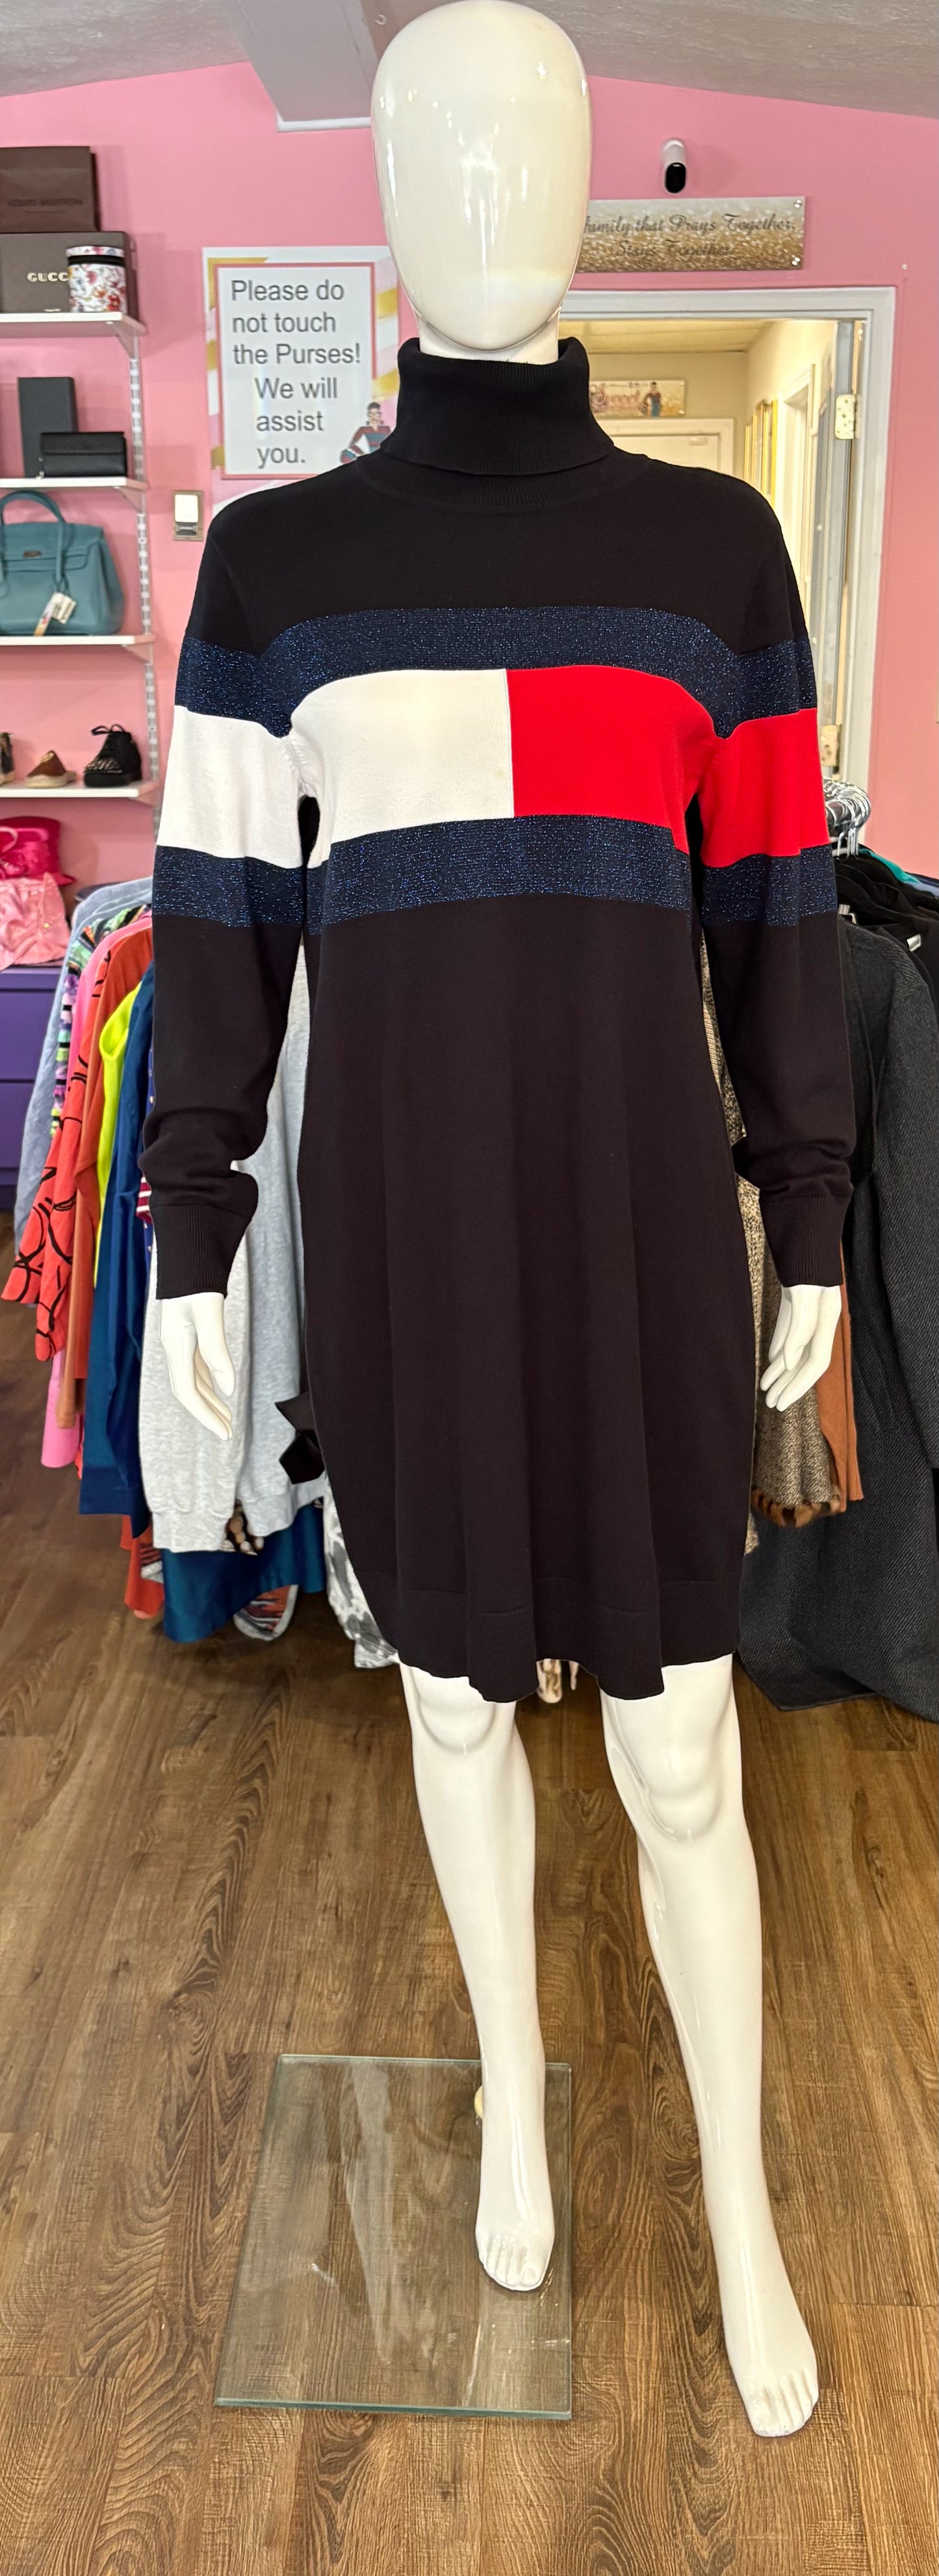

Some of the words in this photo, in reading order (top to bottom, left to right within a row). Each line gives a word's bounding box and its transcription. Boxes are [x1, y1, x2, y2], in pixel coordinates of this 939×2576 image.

[231, 280, 309, 301] Please
[316, 280, 344, 300] do
[233, 313, 268, 333] not
[274, 311, 336, 332] touch
[233, 344, 268, 364] the
[276, 343, 361, 364] Purses!
[255, 378, 293, 398] We
[301, 377, 337, 398] will
[256, 410, 324, 431] assist
[257, 447, 305, 469] you.
